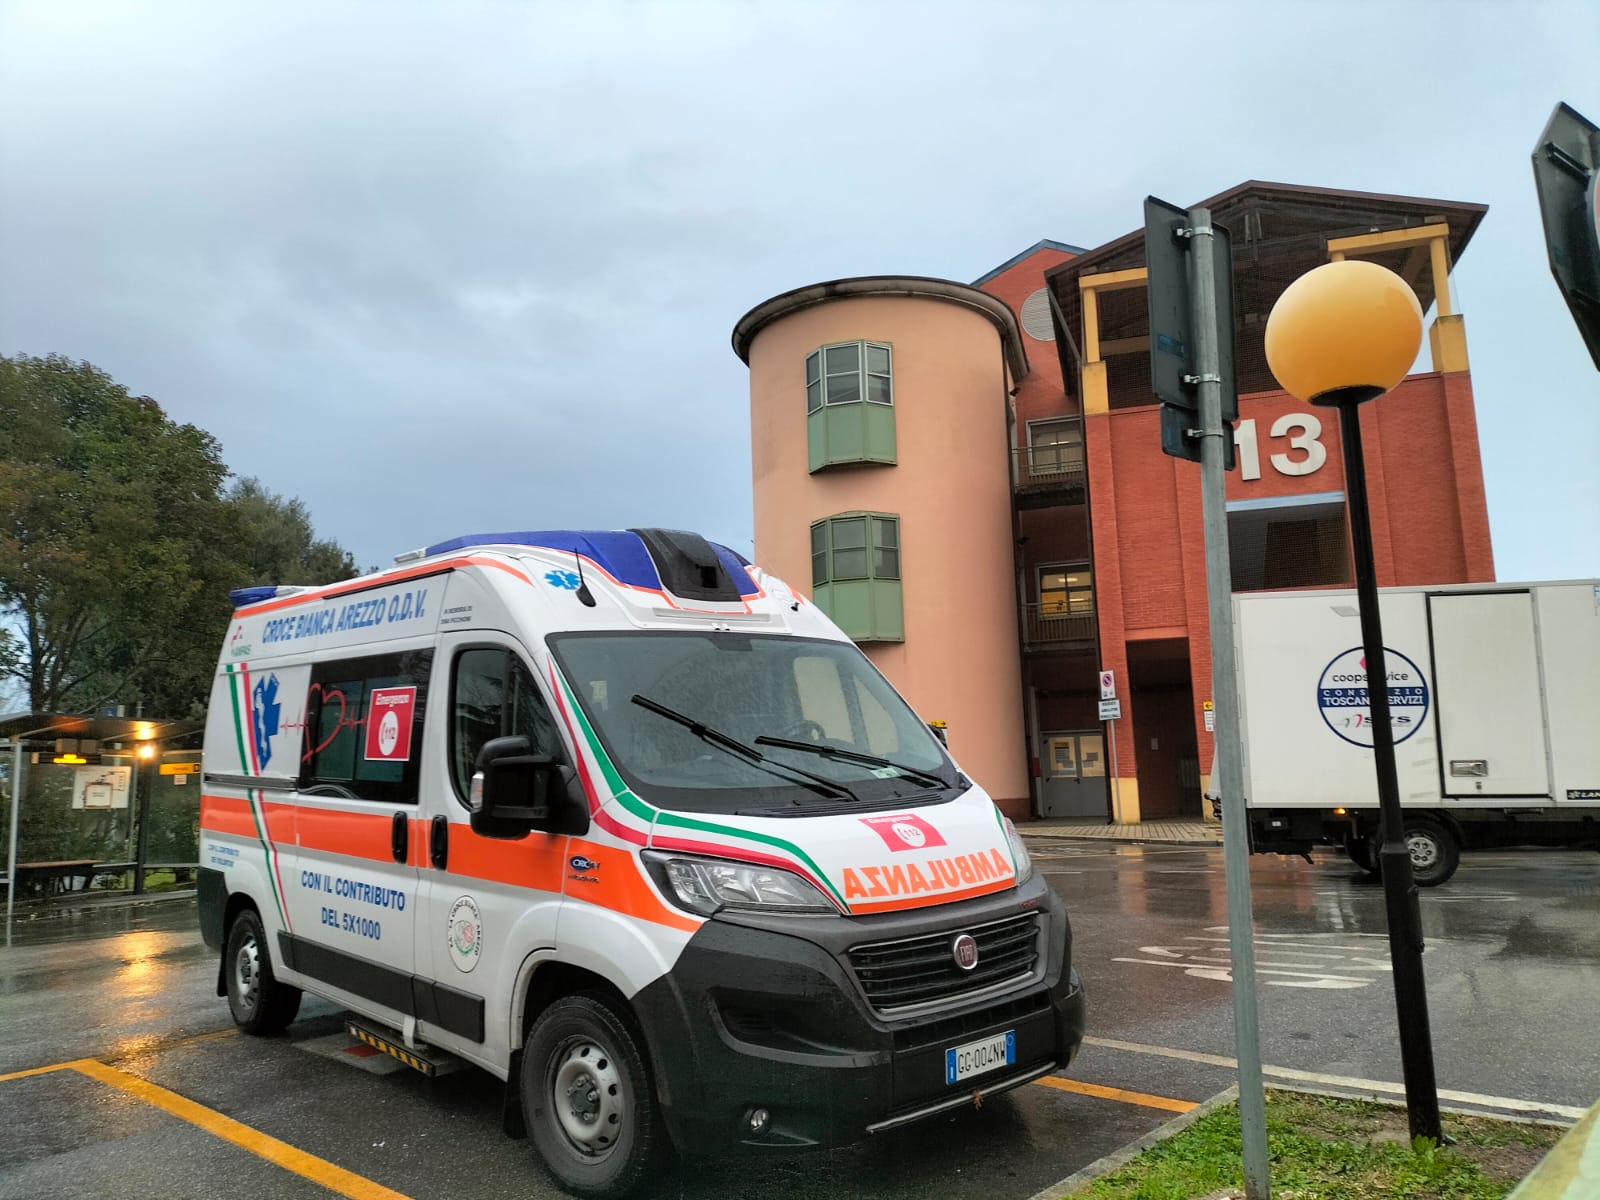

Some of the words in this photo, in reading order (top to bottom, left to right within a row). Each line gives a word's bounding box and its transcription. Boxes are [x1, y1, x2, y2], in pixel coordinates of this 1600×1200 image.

[1233, 412, 1327, 481] 13
[262, 616, 296, 643] CROCE
[294, 608, 336, 639] BIANCA
[335, 597, 387, 632] AREZZO
[387, 589, 428, 623] O.D.V.
[1323, 688, 1422, 697] CONSZIO
[1332, 671, 1408, 684] coopsvice
[1323, 696, 1374, 706] TOSCAN
[1385, 695, 1423, 705] ERVIZI
[300, 870, 320, 891] CON
[323, 878, 333, 895] IL
[335, 880, 406, 912] CONTRIBUTO
[321, 907, 340, 929] DEL
[343, 913, 381, 941] 5X1000
